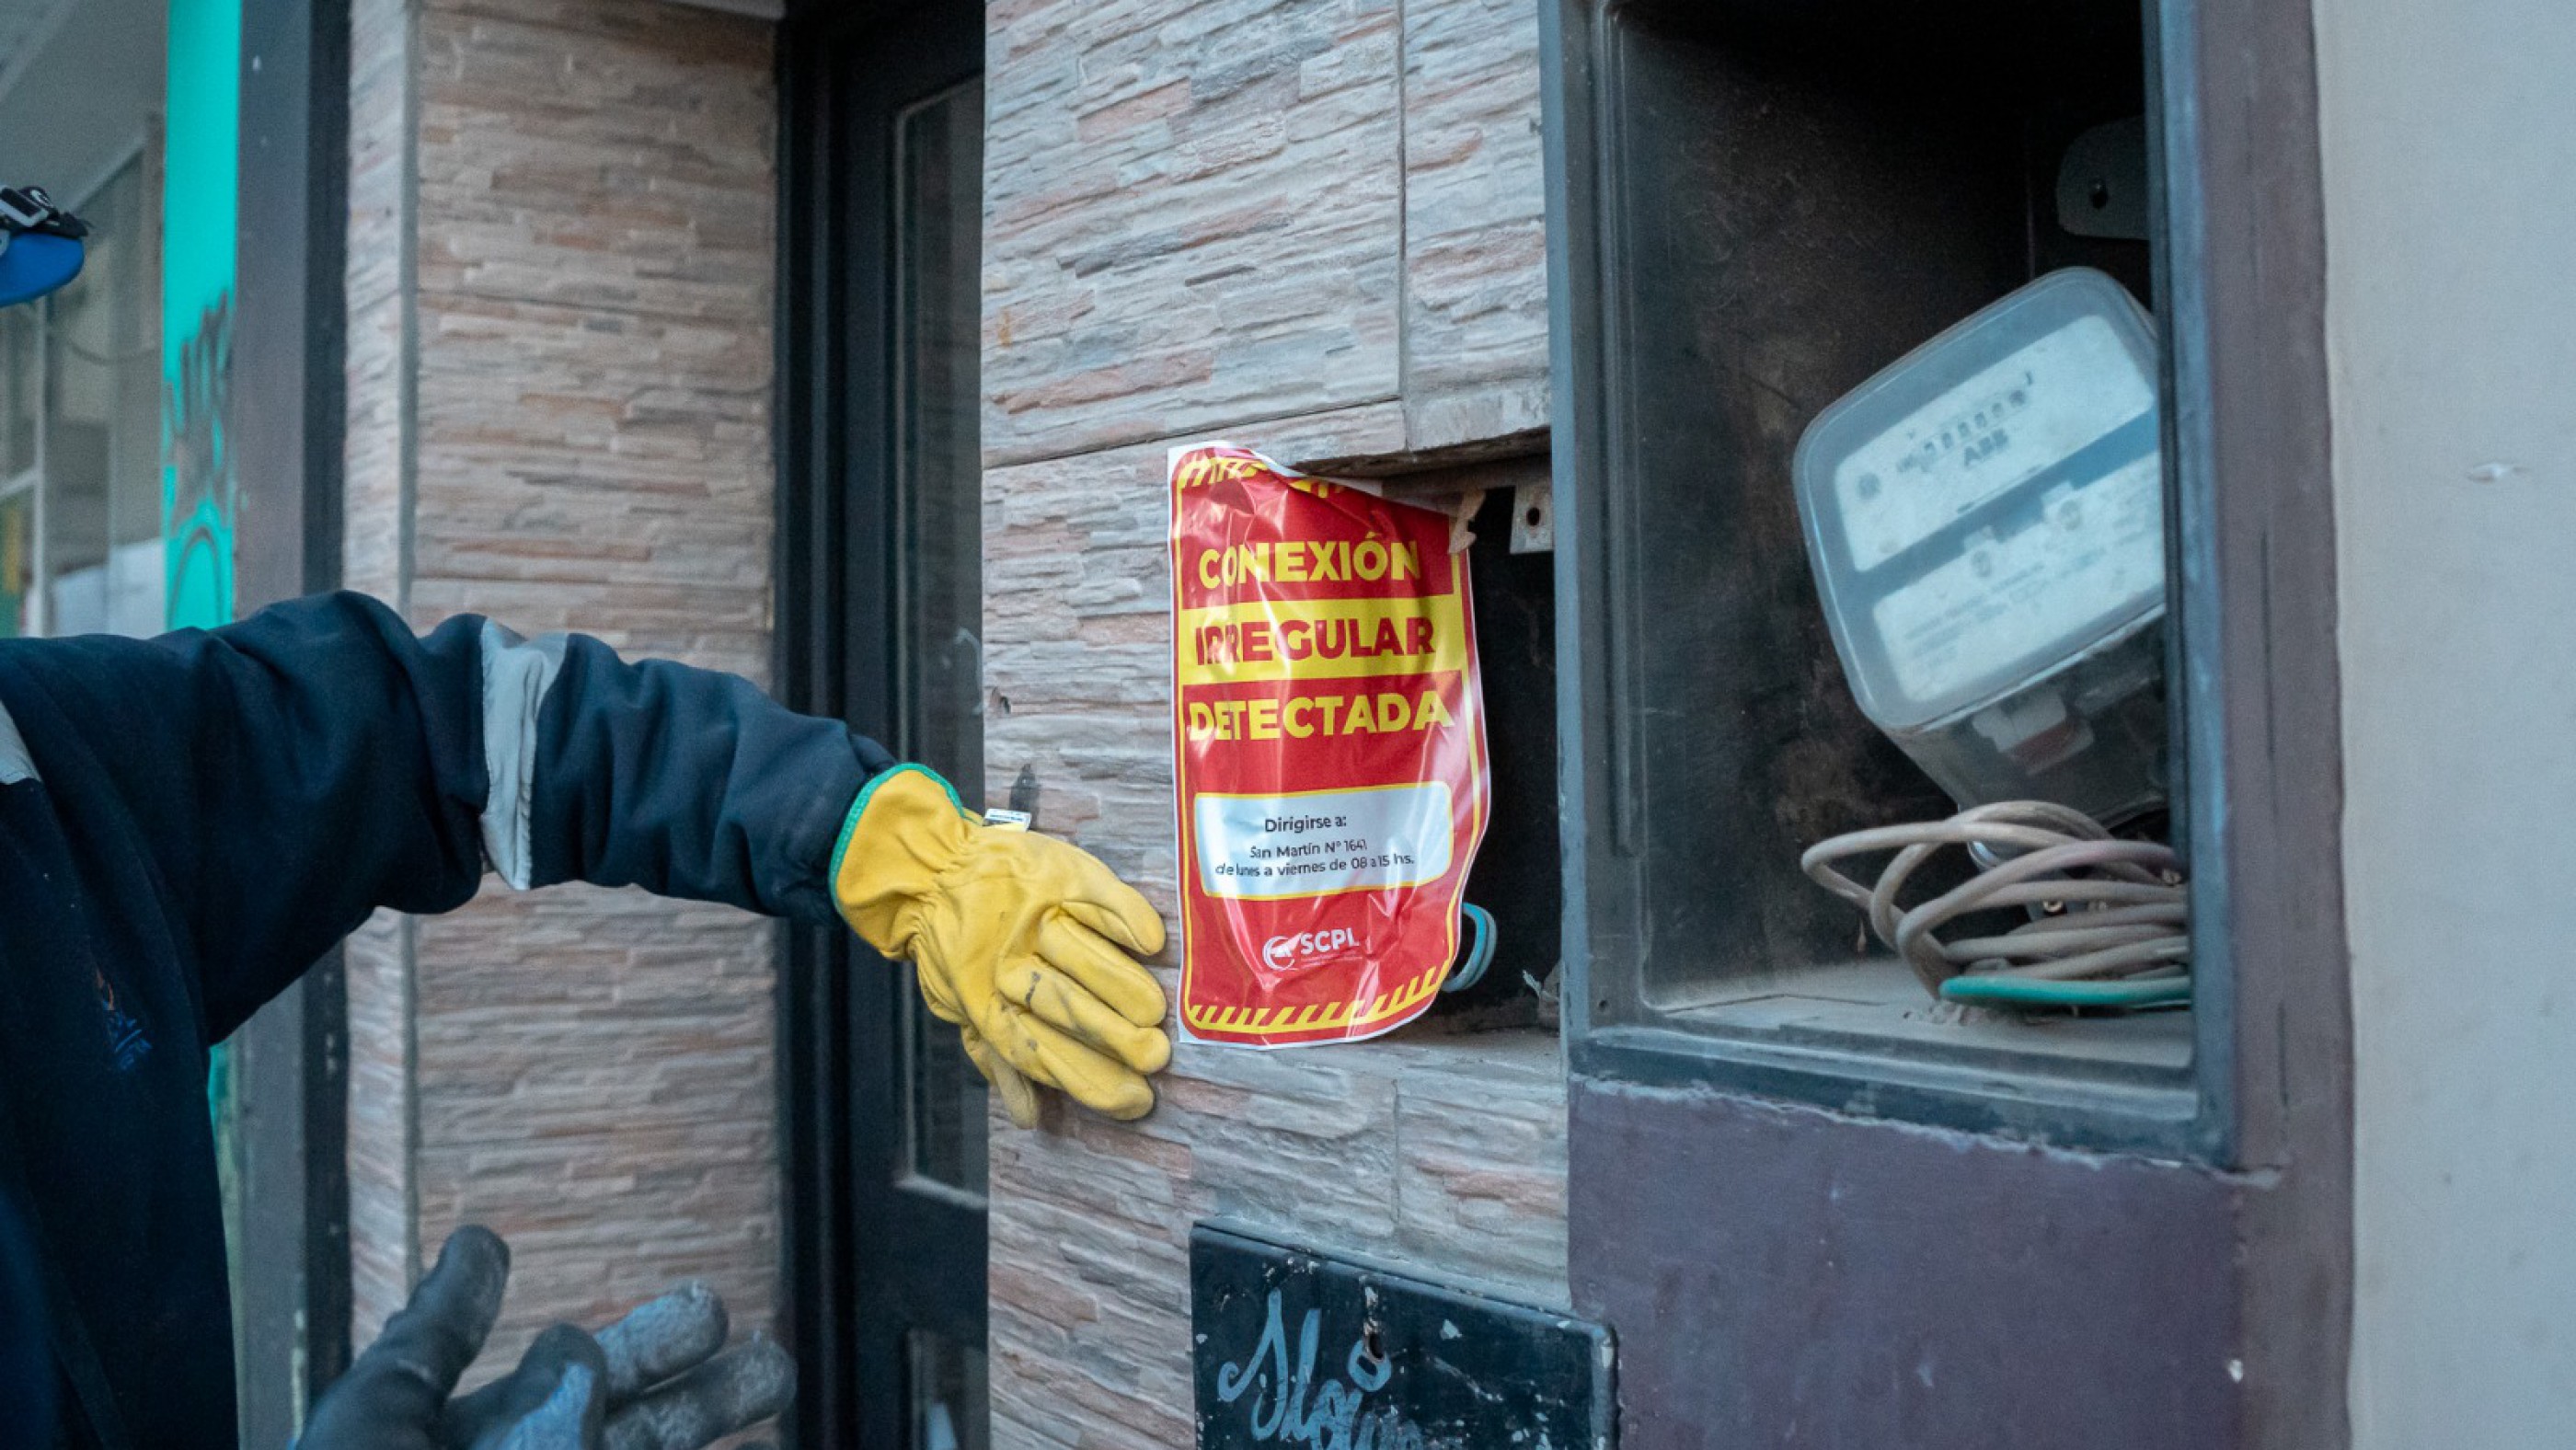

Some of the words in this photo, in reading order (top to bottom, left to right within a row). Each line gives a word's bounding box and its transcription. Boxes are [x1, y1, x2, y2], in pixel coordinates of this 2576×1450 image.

[1199, 532, 1421, 589] CONEXIÓN
[1196, 617, 1435, 665] IRREGULAR
[1189, 691, 1455, 741] DETECTADA
[1264, 815, 1332, 834] Dirigirse
[1334, 816, 1347, 827] a:
[1249, 846, 1271, 858] San
[1276, 841, 1321, 858] Martín
[1215, 863, 1234, 875] de
[1263, 867, 1273, 876] a
[1277, 861, 1326, 876] viernes
[1329, 858, 1347, 871] de
[1351, 857, 1367, 869] 08
[1370, 857, 1377, 868] a
[1378, 855, 1390, 867] 15
[1394, 854, 1415, 864] hs.
[1300, 927, 1360, 955] SCPL
